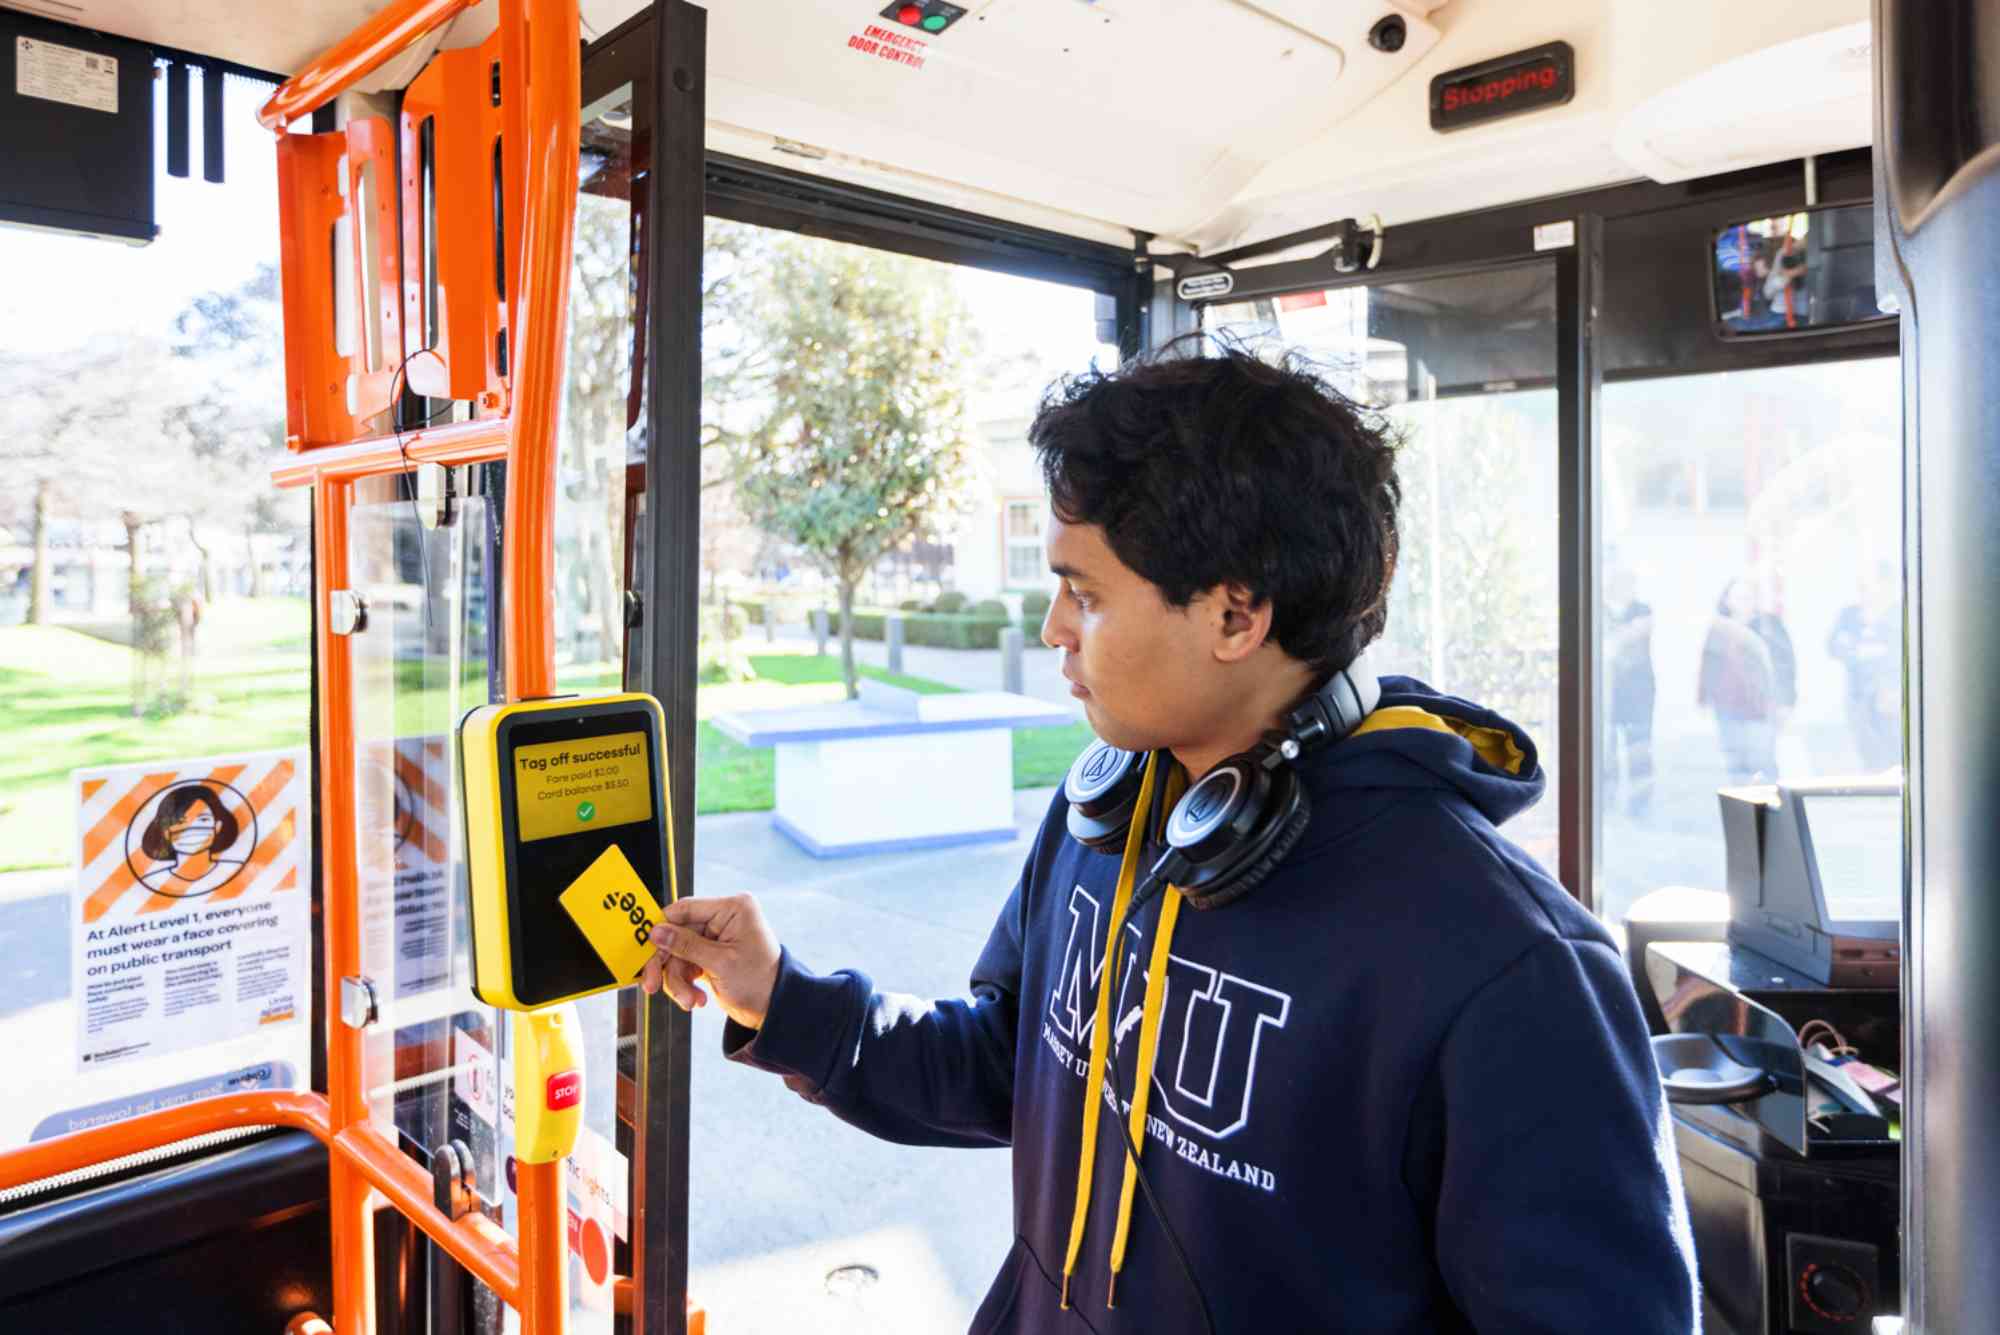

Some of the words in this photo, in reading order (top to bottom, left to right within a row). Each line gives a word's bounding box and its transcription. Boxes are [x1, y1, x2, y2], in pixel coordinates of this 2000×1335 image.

[848, 35, 879, 54] DOOR
[1441, 64, 1559, 111] Stopping
[520, 757, 547, 771] Tag
[550, 752, 570, 766] off
[572, 743, 641, 764] successful
[537, 788, 563, 801] Card
[565, 782, 603, 797] balance
[546, 773, 569, 784] Fare
[571, 769, 592, 782] paid
[87, 929, 104, 943] At
[108, 923, 146, 939] Alert
[149, 914, 190, 931] Level
[205, 901, 272, 921] everyone
[87, 943, 127, 959] must
[130, 936, 169, 950] wear
[171, 935, 180, 943] a
[183, 928, 215, 941] face
[217, 915, 279, 935] covering
[87, 964, 107, 977] on
[111, 955, 159, 974] public
[161, 940, 232, 963] transport
[1146, 1115, 1175, 1148] NEW
[1176, 1136, 1276, 1192] ZEALAND
